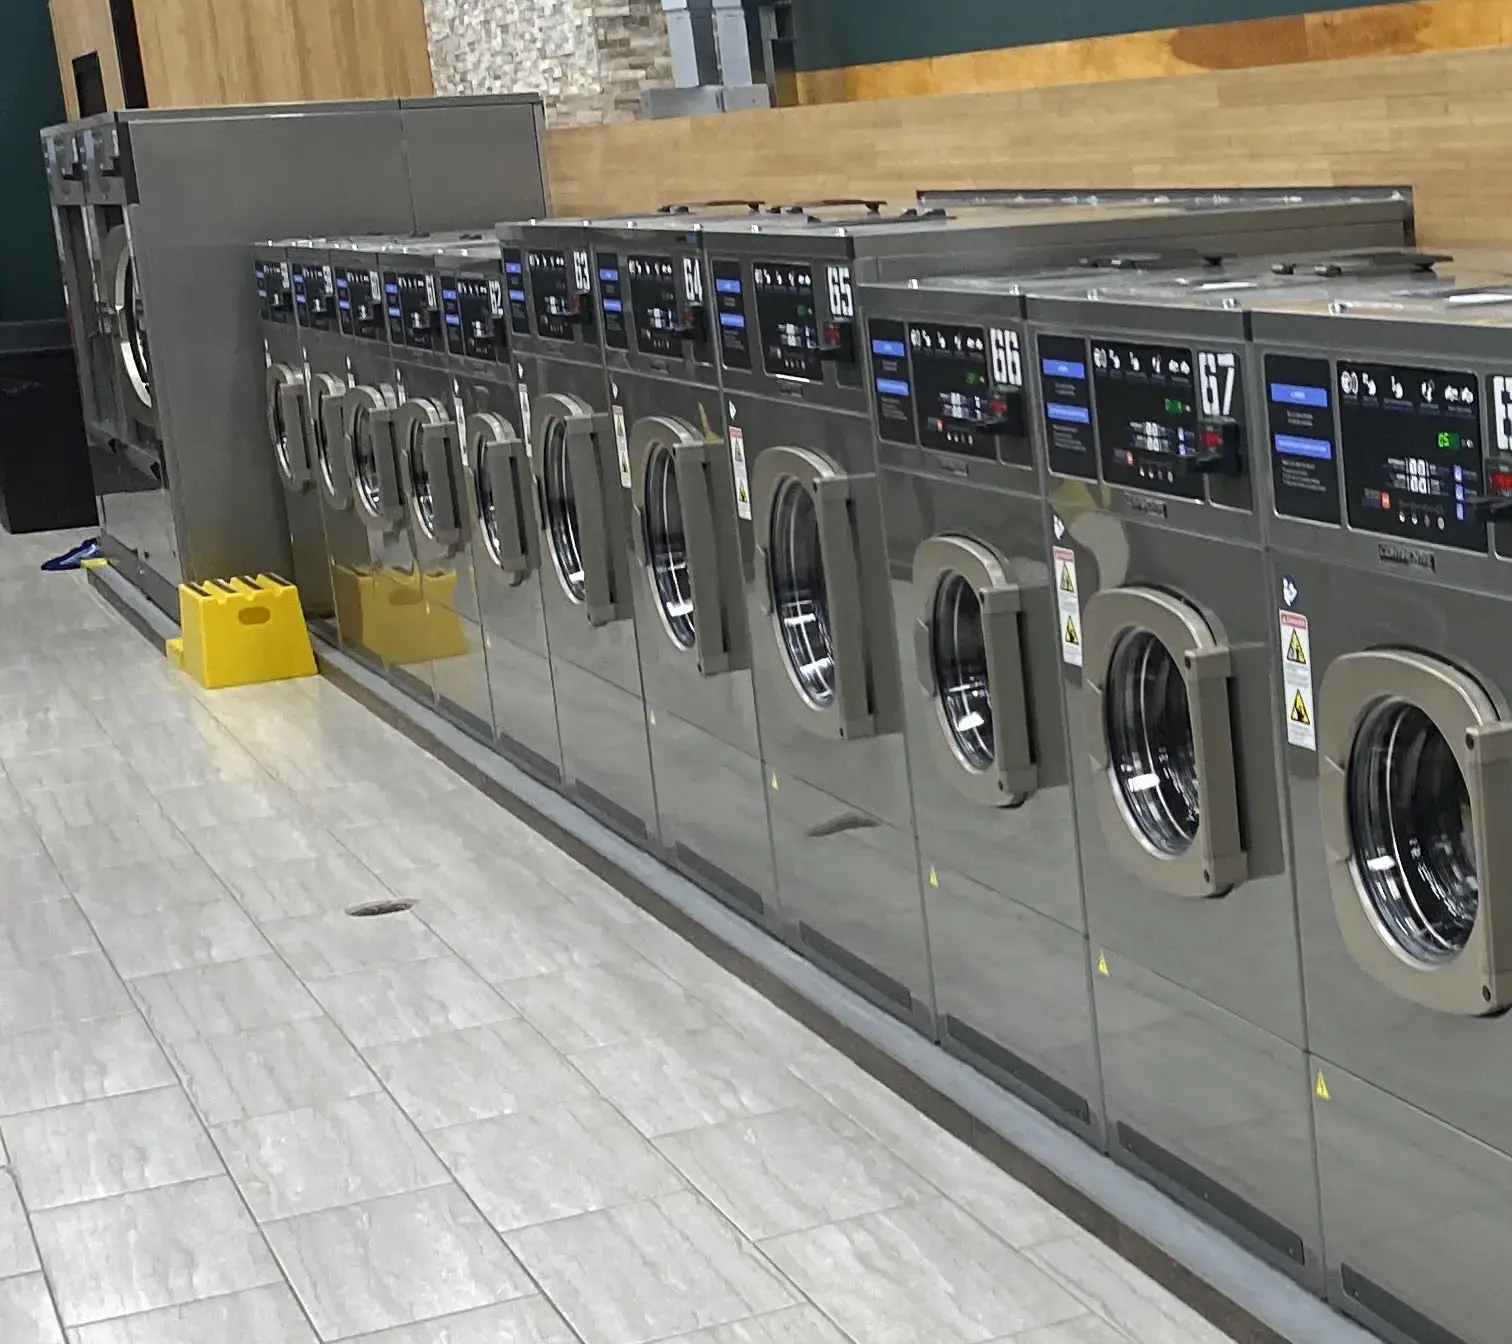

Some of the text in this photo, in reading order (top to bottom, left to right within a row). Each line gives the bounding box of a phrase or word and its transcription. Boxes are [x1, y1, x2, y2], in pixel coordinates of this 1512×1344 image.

[573, 251, 591, 291] 63
[683, 257, 703, 301] 64
[826, 265, 854, 317] 65
[989, 327, 1022, 386] 66
[1199, 351, 1236, 415] 67
